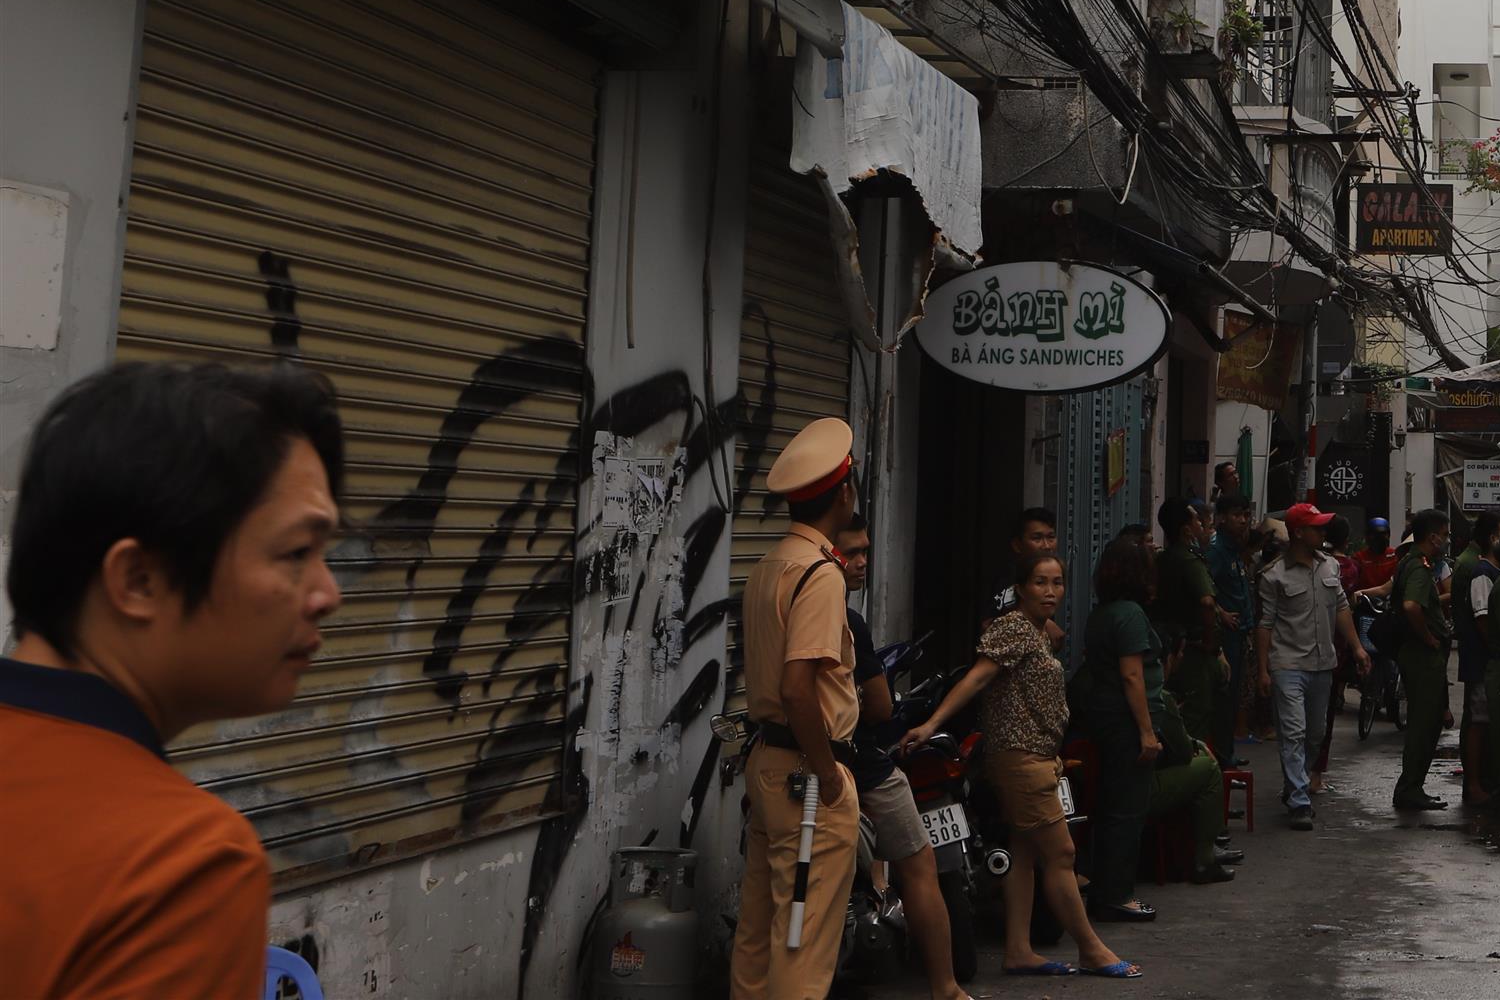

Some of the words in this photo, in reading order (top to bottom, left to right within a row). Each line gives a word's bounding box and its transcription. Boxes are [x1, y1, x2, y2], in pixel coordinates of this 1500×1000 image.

[951, 343, 972, 364] BÀ
[977, 342, 1015, 365] ÁNG
[1019, 348, 1125, 367] SANDWICHES
